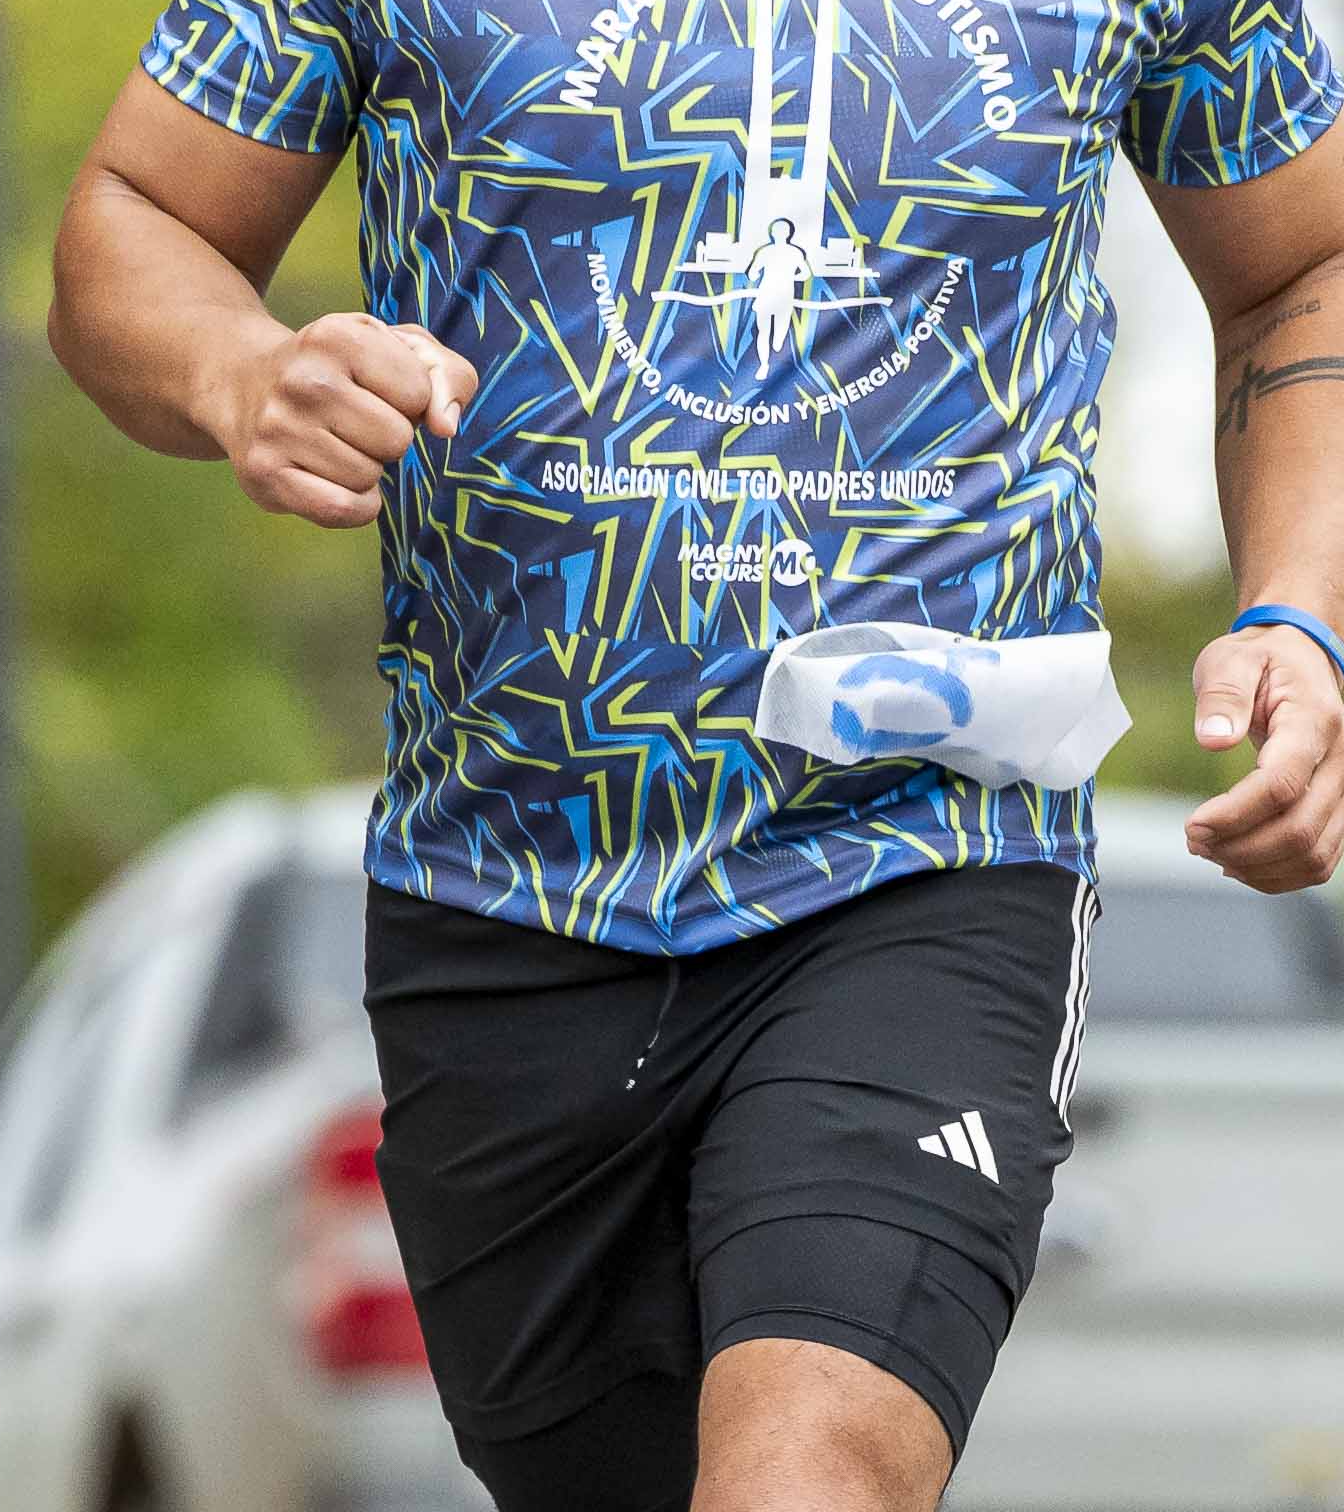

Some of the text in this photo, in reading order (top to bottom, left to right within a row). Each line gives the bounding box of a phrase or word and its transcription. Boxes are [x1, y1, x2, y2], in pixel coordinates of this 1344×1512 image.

[586, 253, 967, 426] MOVIMIENTO, INCLUSIÓN Y ENERGÍA POSITIVA
[541, 460, 956, 501] ASOCIACIÓN CIVIL TGD PADRES UNIDOS
[677, 543, 767, 563] MAGNY
[690, 562, 765, 582] COURS
